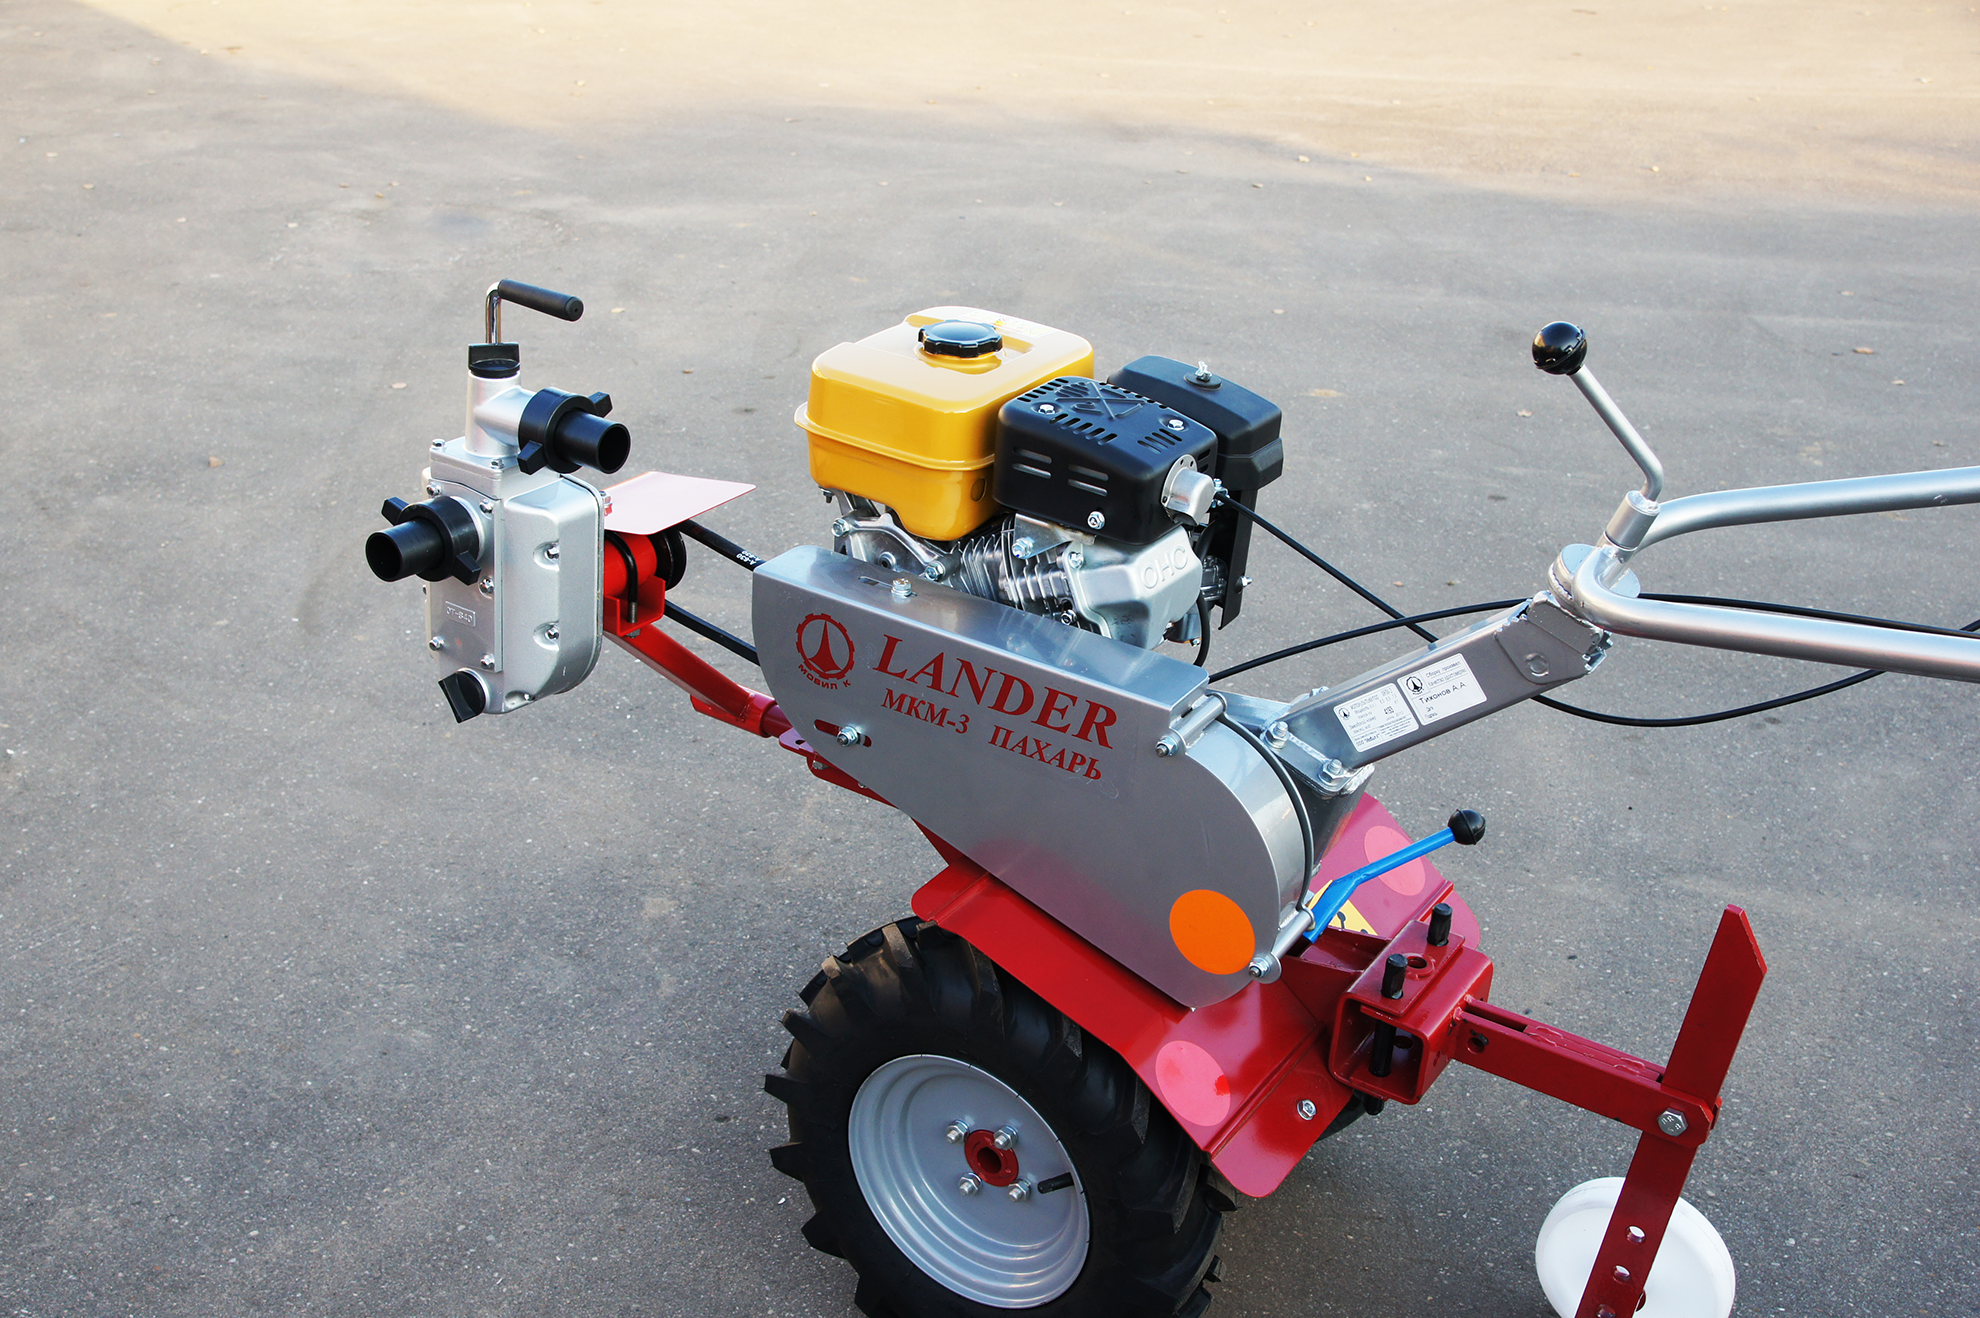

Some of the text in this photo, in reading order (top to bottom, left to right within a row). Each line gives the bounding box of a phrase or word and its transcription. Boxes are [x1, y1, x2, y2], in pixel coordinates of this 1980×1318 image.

[1140, 545, 1188, 589] OHC
[873, 634, 1118, 749] LANDER
[1419, 688, 1451, 704] Тихонов
[881, 688, 1102, 780] МКМ-3 ПАХАРЬ
